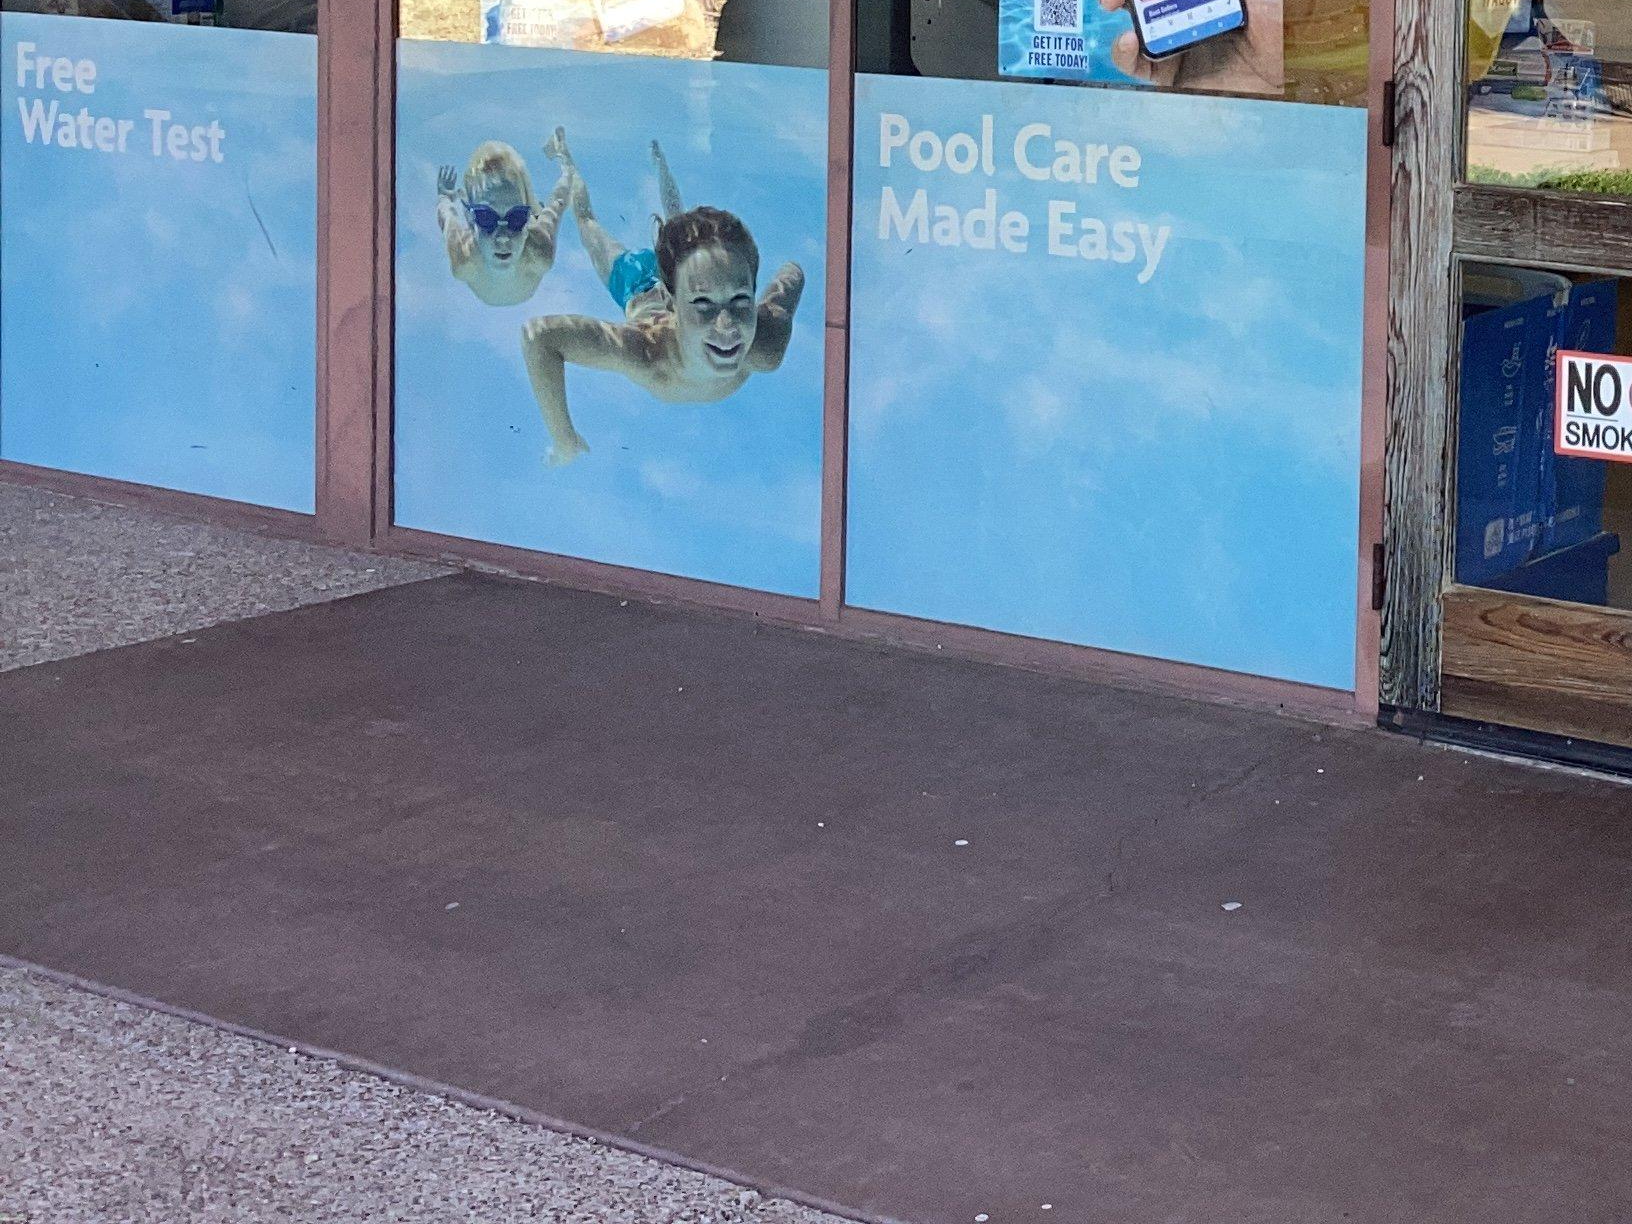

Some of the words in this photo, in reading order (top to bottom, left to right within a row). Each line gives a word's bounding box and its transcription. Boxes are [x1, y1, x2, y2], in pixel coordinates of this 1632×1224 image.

[17, 42, 97, 94] Free
[1028, 52, 1052, 66] FREE
[1055, 53, 1088, 69] TODAY!
[1033, 35, 1052, 50] GET
[1054, 37, 1062, 50] IT
[1065, 38, 1084, 52] FOR
[18, 97, 134, 152] Water
[144, 109, 225, 163] Test
[879, 112, 996, 176] Pool
[1013, 123, 1141, 188] Care
[878, 186, 1029, 253] Made
[1048, 200, 1171, 284] Easy
[1567, 361, 1622, 416] NO
